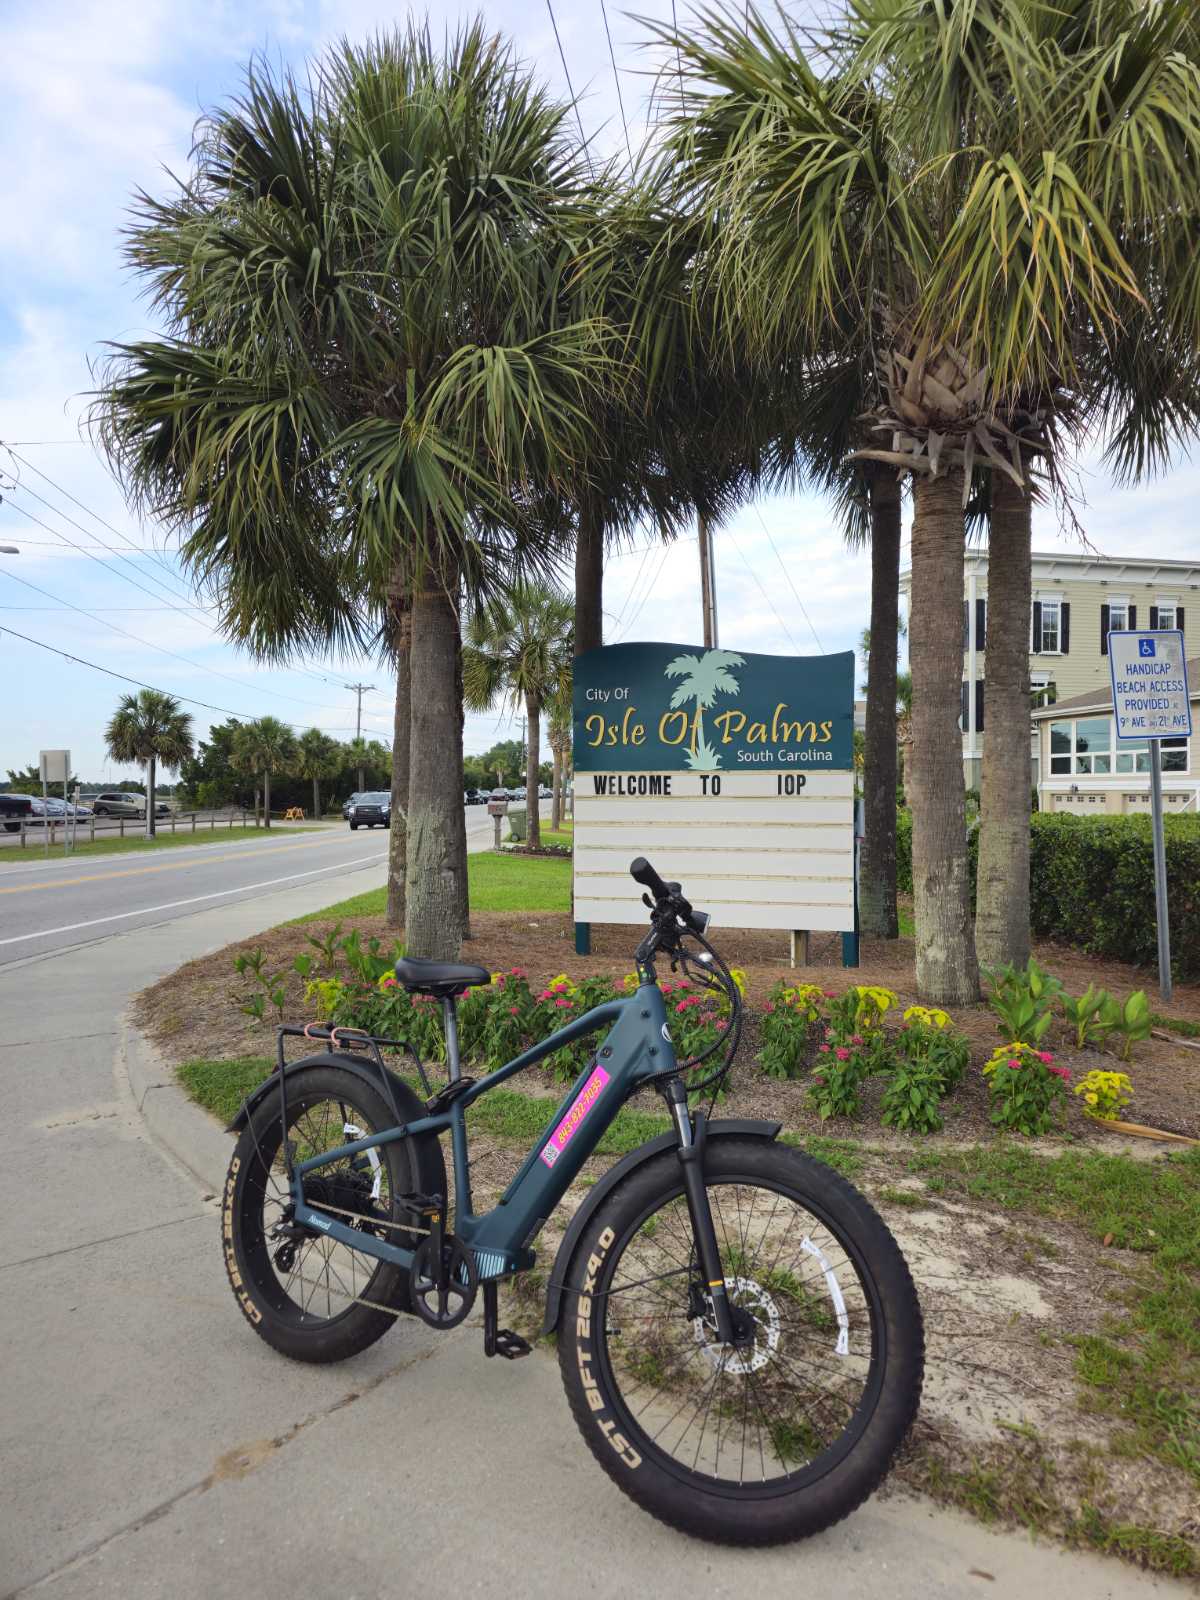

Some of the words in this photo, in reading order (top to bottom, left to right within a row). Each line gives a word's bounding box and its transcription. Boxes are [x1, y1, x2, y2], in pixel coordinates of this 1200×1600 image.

[1126, 663, 1171, 676] HANDICAP
[1117, 681, 1146, 693] BEACH
[1150, 680, 1184, 692] ACCESS
[585, 688, 610, 702] City
[614, 687, 630, 700] Of
[1125, 698, 1170, 710] PROVIDED
[1131, 716, 1146, 727] AVE
[1172, 714, 1187, 726] AVE
[585, 706, 647, 747] Isle
[658, 707, 707, 757] Of
[713, 703, 834, 744] Palms
[737, 750, 774, 762] South
[778, 749, 833, 762] Carolina
[594, 775, 672, 796] WELCOME
[700, 774, 721, 796] TO
[777, 774, 807, 796] IOP
[239, 1292, 262, 1324] CST
[577, 1346, 605, 1412] BFT
[597, 1418, 642, 1469] CST
